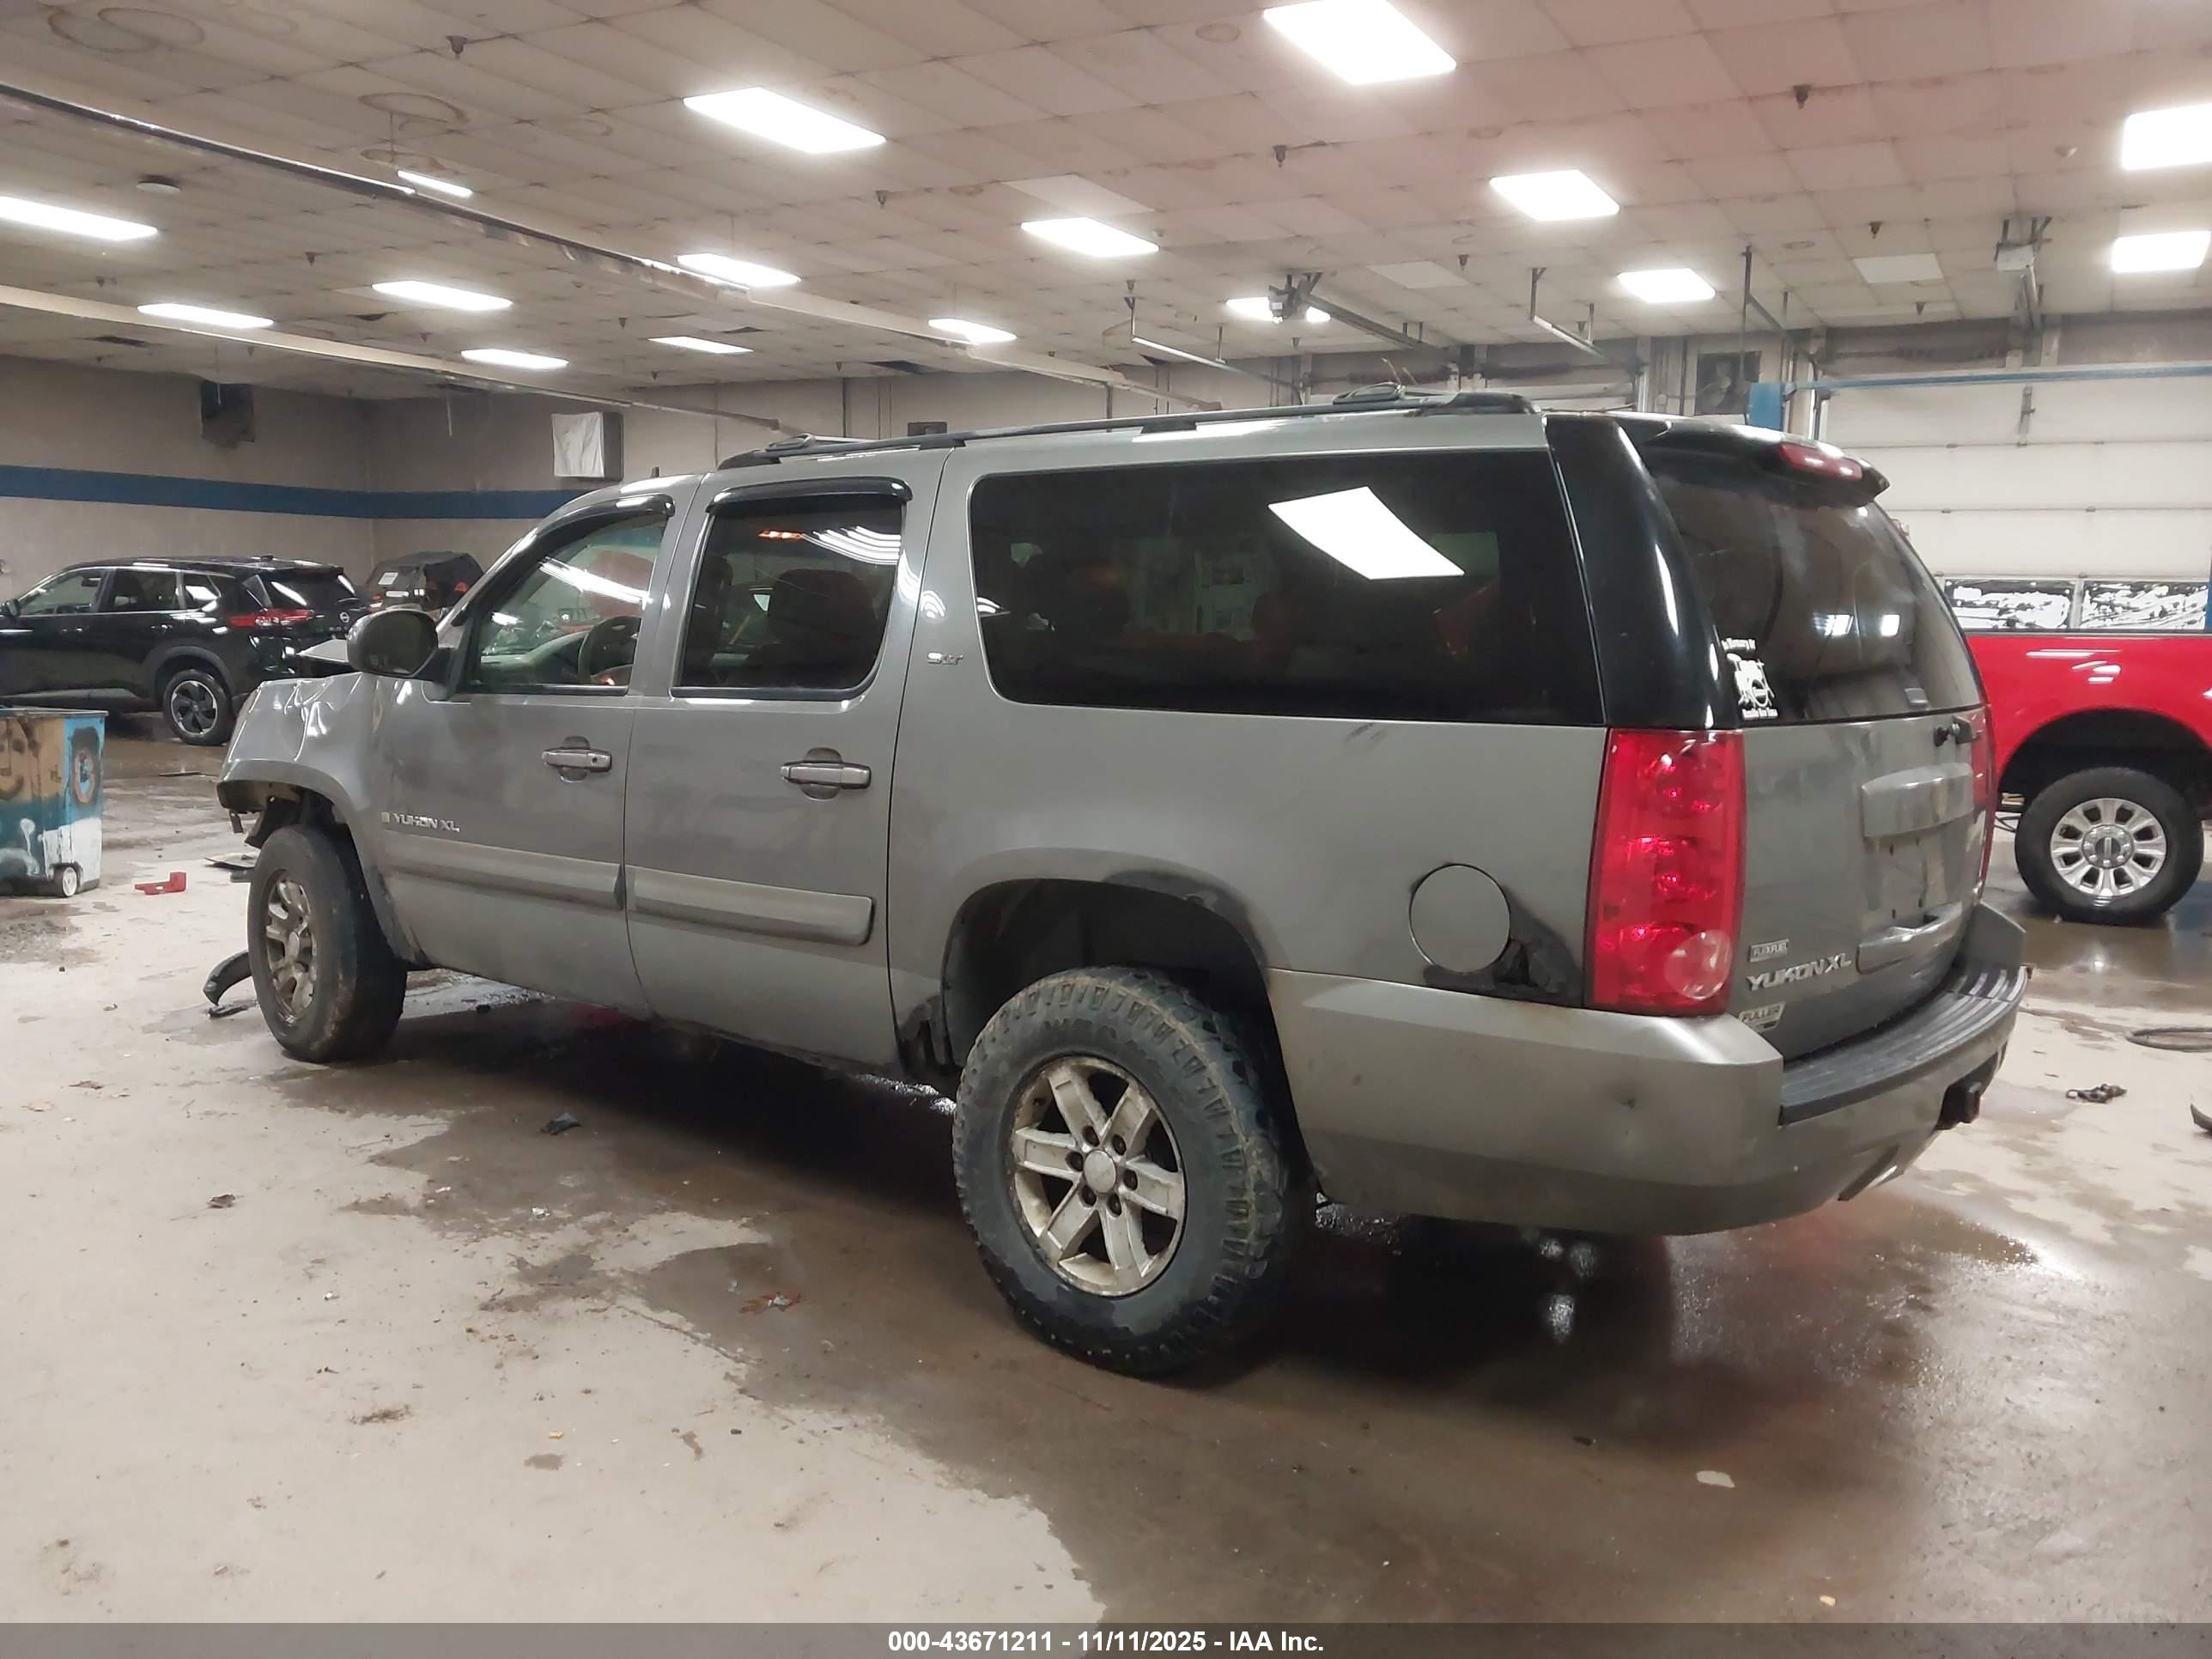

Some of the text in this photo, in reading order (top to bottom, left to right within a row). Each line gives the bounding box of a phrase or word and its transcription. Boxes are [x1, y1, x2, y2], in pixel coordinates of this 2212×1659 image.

[392, 812, 460, 832] YUKON XL
[1746, 952, 1852, 991] YUKON XL
